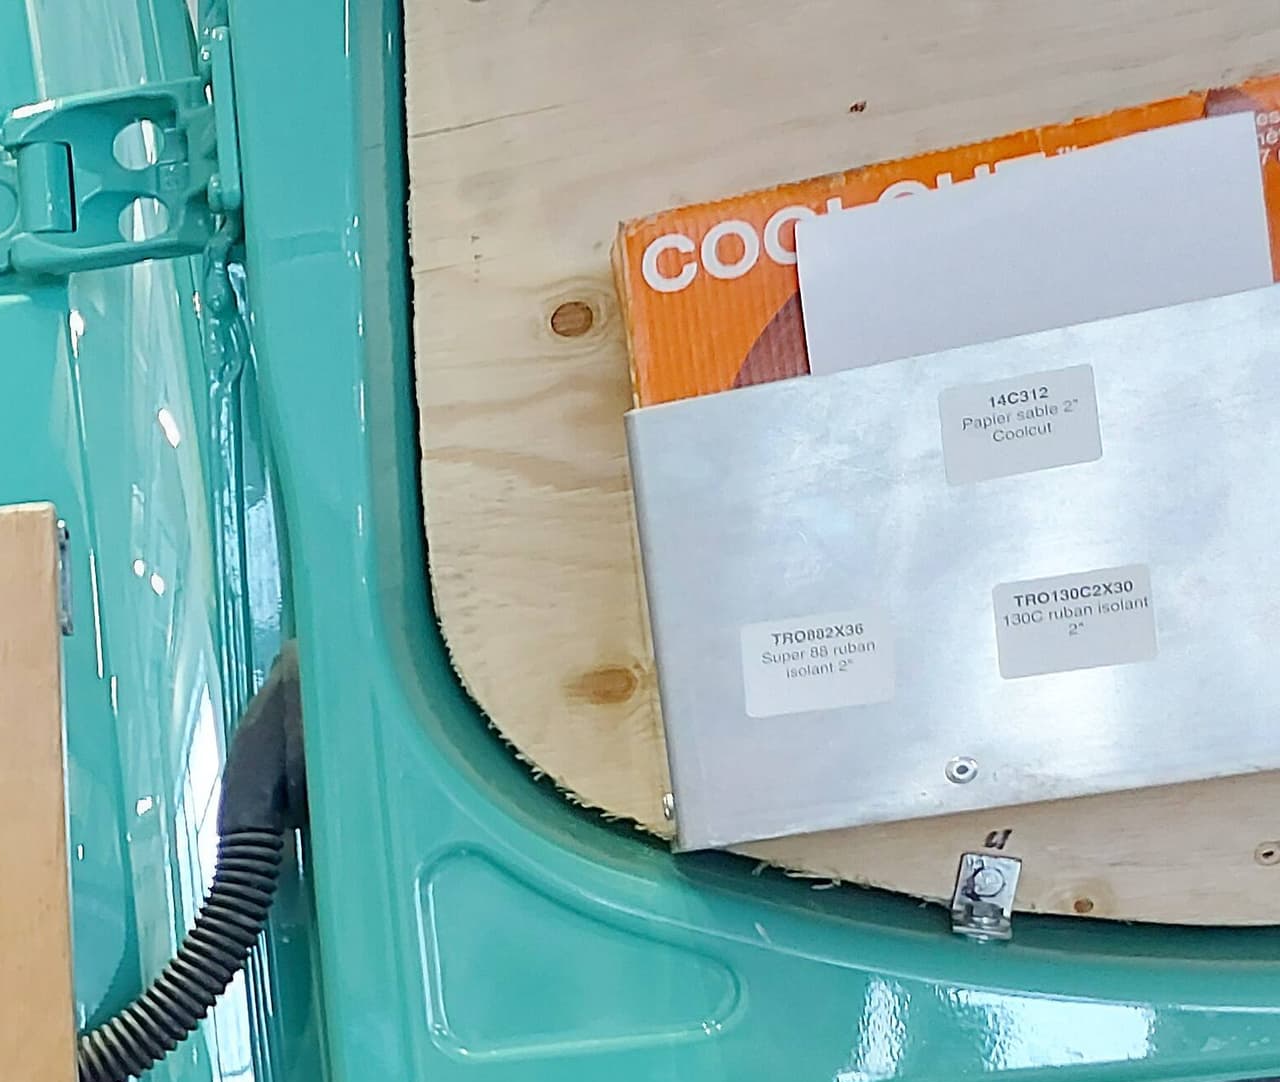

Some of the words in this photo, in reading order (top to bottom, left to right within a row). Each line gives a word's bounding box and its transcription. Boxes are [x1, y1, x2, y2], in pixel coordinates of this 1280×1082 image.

[989, 387, 1049, 408] 14C312
[961, 413, 1011, 431] Papier
[1016, 404, 1059, 421] sable
[992, 422, 1052, 442] Coolcut
[1013, 580, 1133, 608] TRO130C2X30
[1003, 611, 1044, 627] 130C
[1048, 605, 1093, 621] ruban
[1098, 596, 1149, 615] isolant
[761, 651, 806, 666] Super
[810, 646, 828, 659] 88
[833, 641, 876, 657] ruban
[786, 662, 834, 679] isolant
